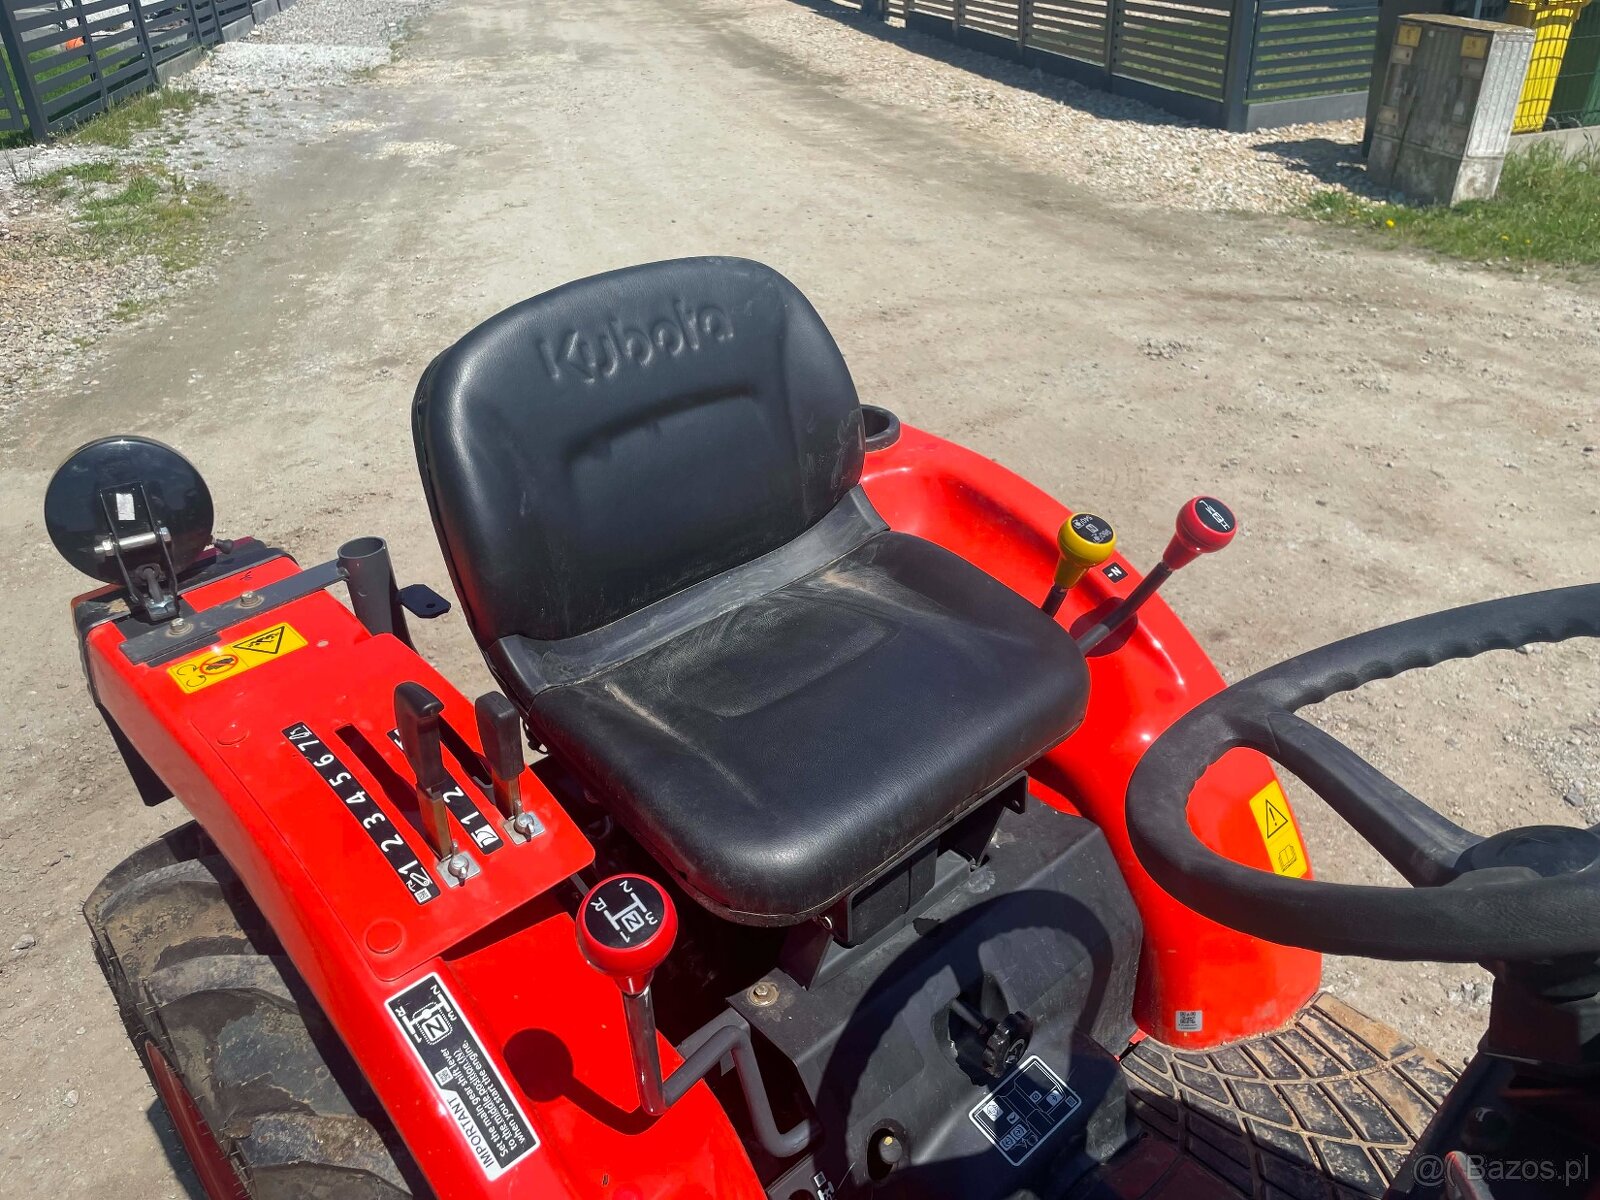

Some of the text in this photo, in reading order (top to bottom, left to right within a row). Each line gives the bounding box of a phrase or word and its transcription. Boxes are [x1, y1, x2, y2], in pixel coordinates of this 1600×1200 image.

[535, 298, 735, 385] Kubota
[297, 739, 418, 875] 1 2 3 4 5 6 7
[442, 786, 480, 825] 1 2
[619, 880, 633, 893] 2
[590, 897, 607, 912] R
[645, 911, 658, 926] 3
[620, 931, 631, 943] 1
[430, 984, 441, 995] 2
[395, 1006, 407, 1017] R
[447, 1010, 457, 1021] 3
[424, 1016, 447, 1039] N
[462, 1061, 488, 1098] position
[461, 1039, 526, 1144] when you start the engine.
[440, 1047, 509, 1157] Set the main gear shift lever
[479, 1095, 503, 1125] middle
[447, 1097, 494, 1168] IMPORTANT
[499, 1123, 512, 1141] the
[508, 1138, 517, 1151] to
